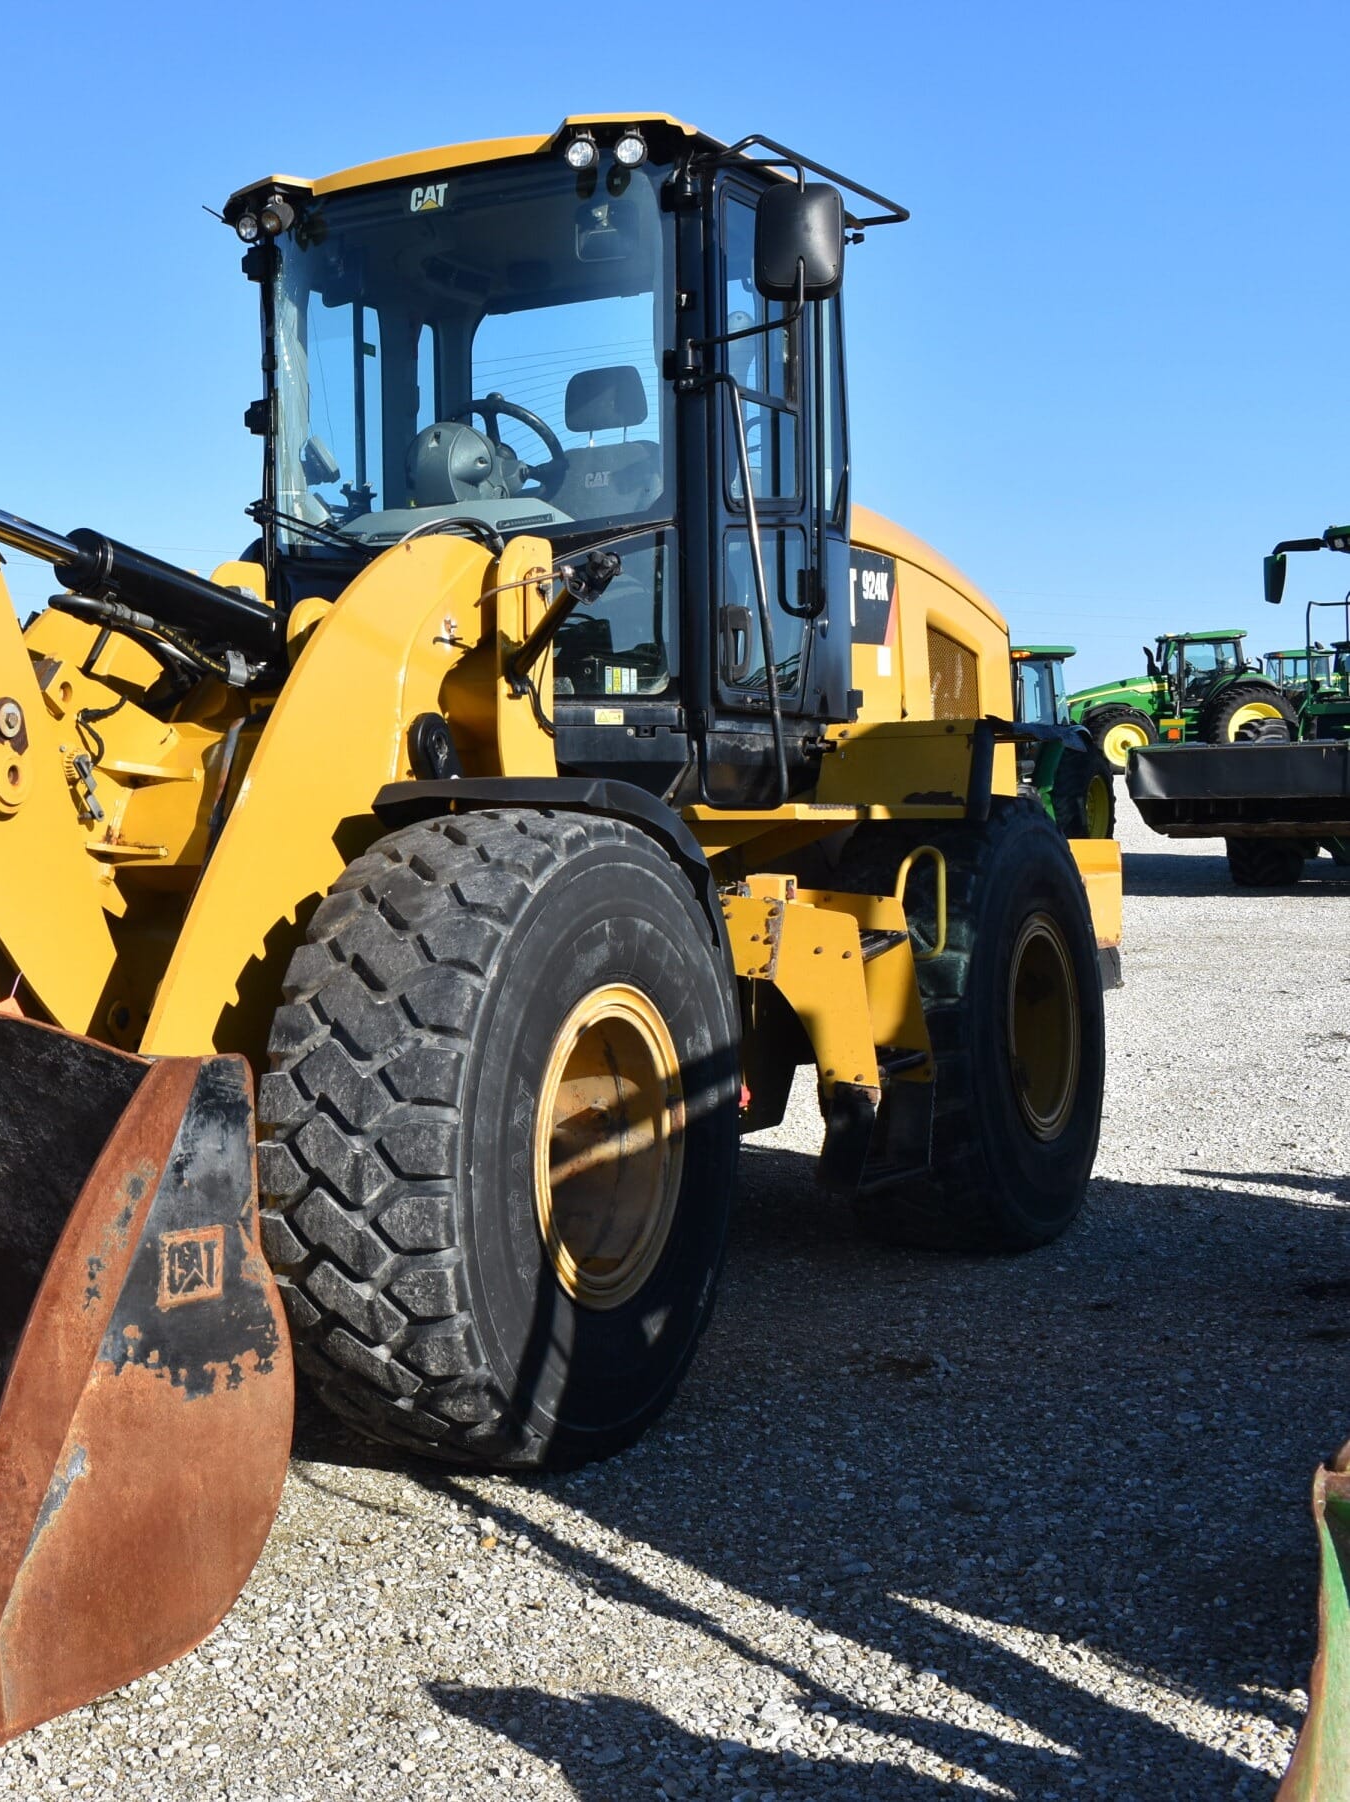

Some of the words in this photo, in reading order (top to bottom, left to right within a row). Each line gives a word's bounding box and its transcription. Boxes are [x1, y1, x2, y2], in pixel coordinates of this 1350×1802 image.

[410, 183, 448, 212] CAT
[584, 470, 611, 489] CAT
[861, 569, 889, 602] 924K
[168, 1239, 218, 1298] CAT
